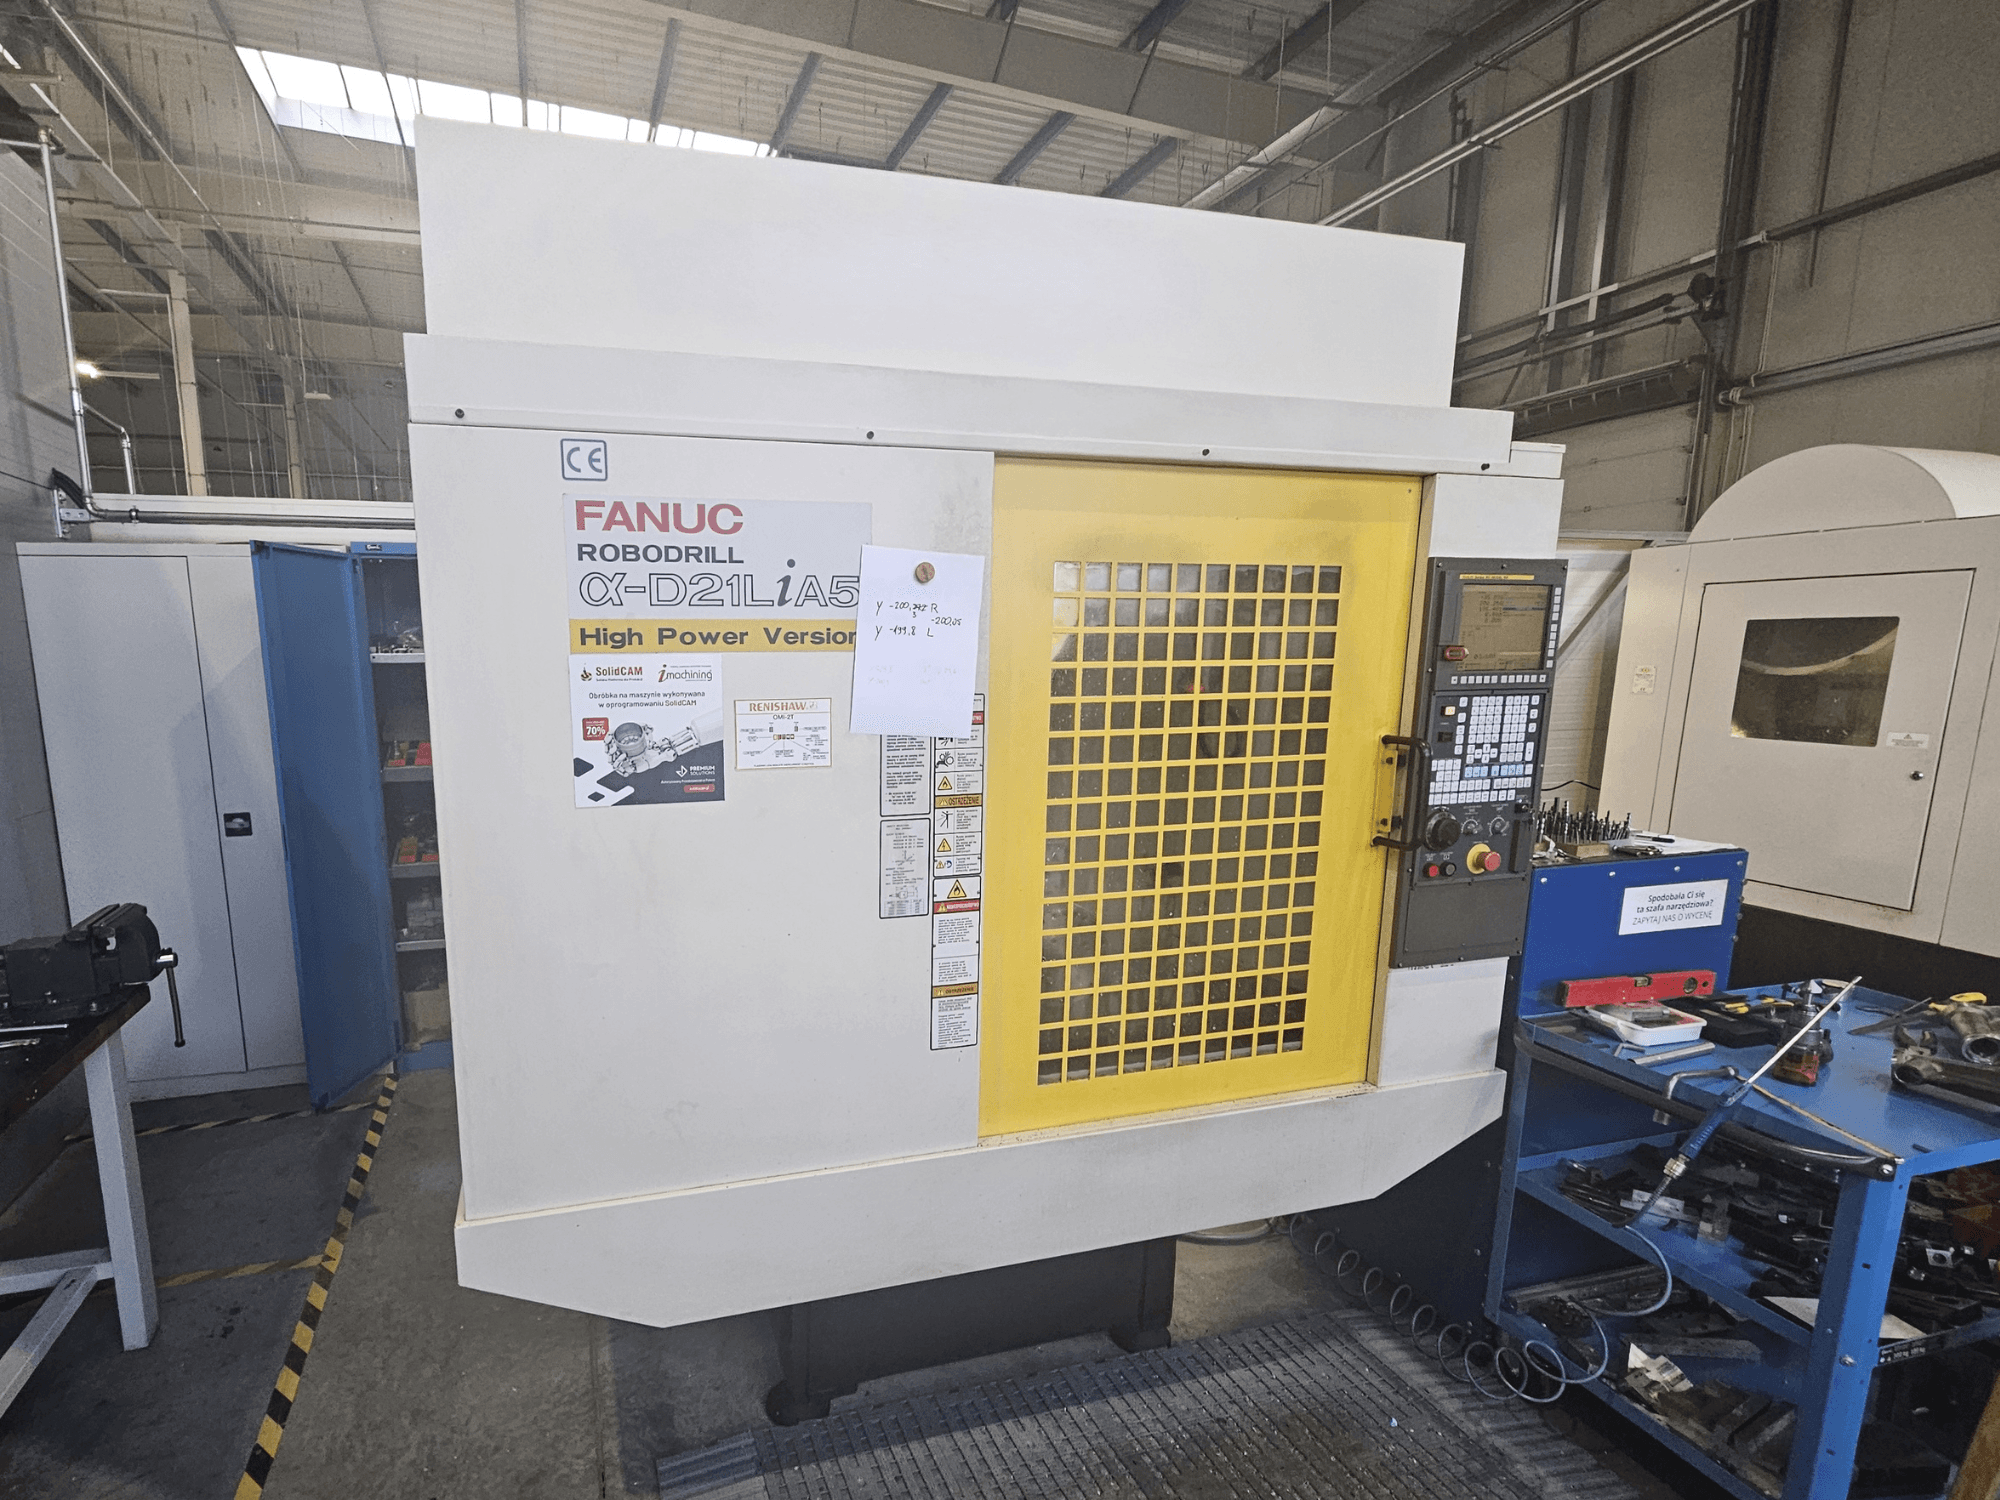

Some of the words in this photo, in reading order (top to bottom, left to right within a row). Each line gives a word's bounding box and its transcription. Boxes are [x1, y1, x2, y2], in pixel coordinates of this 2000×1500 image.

[566, 446, 602, 473] CE
[575, 499, 744, 535] FANUC
[577, 543, 744, 564] ROBODRILL
[930, 602, 939, 614] R
[580, 627, 643, 649] High
[657, 627, 749, 645] Power
[926, 627, 934, 638] L
[595, 666, 643, 676] SolidCAM
[629, 691, 661, 700] maszynie
[662, 690, 706, 699] wykonywana
[606, 701, 664, 709] oprogramowaniu
[664, 699, 697, 707] SolidCAM
[749, 701, 807, 712] RENISHAW
[586, 726, 606, 736] 70%
[1687, 891, 1694, 899] Ci
[1695, 890, 1706, 899] się
[1636, 906, 1644, 914] ta
[1645, 903, 1664, 913] szafa
[1666, 899, 1714, 911] narzędziowa?
[1632, 915, 1662, 925] ZAPYTAJ
[1662, 913, 1676, 923] NAS
[1677, 913, 1683, 921] O
[1685, 910, 1713, 920] WYCENĘ
